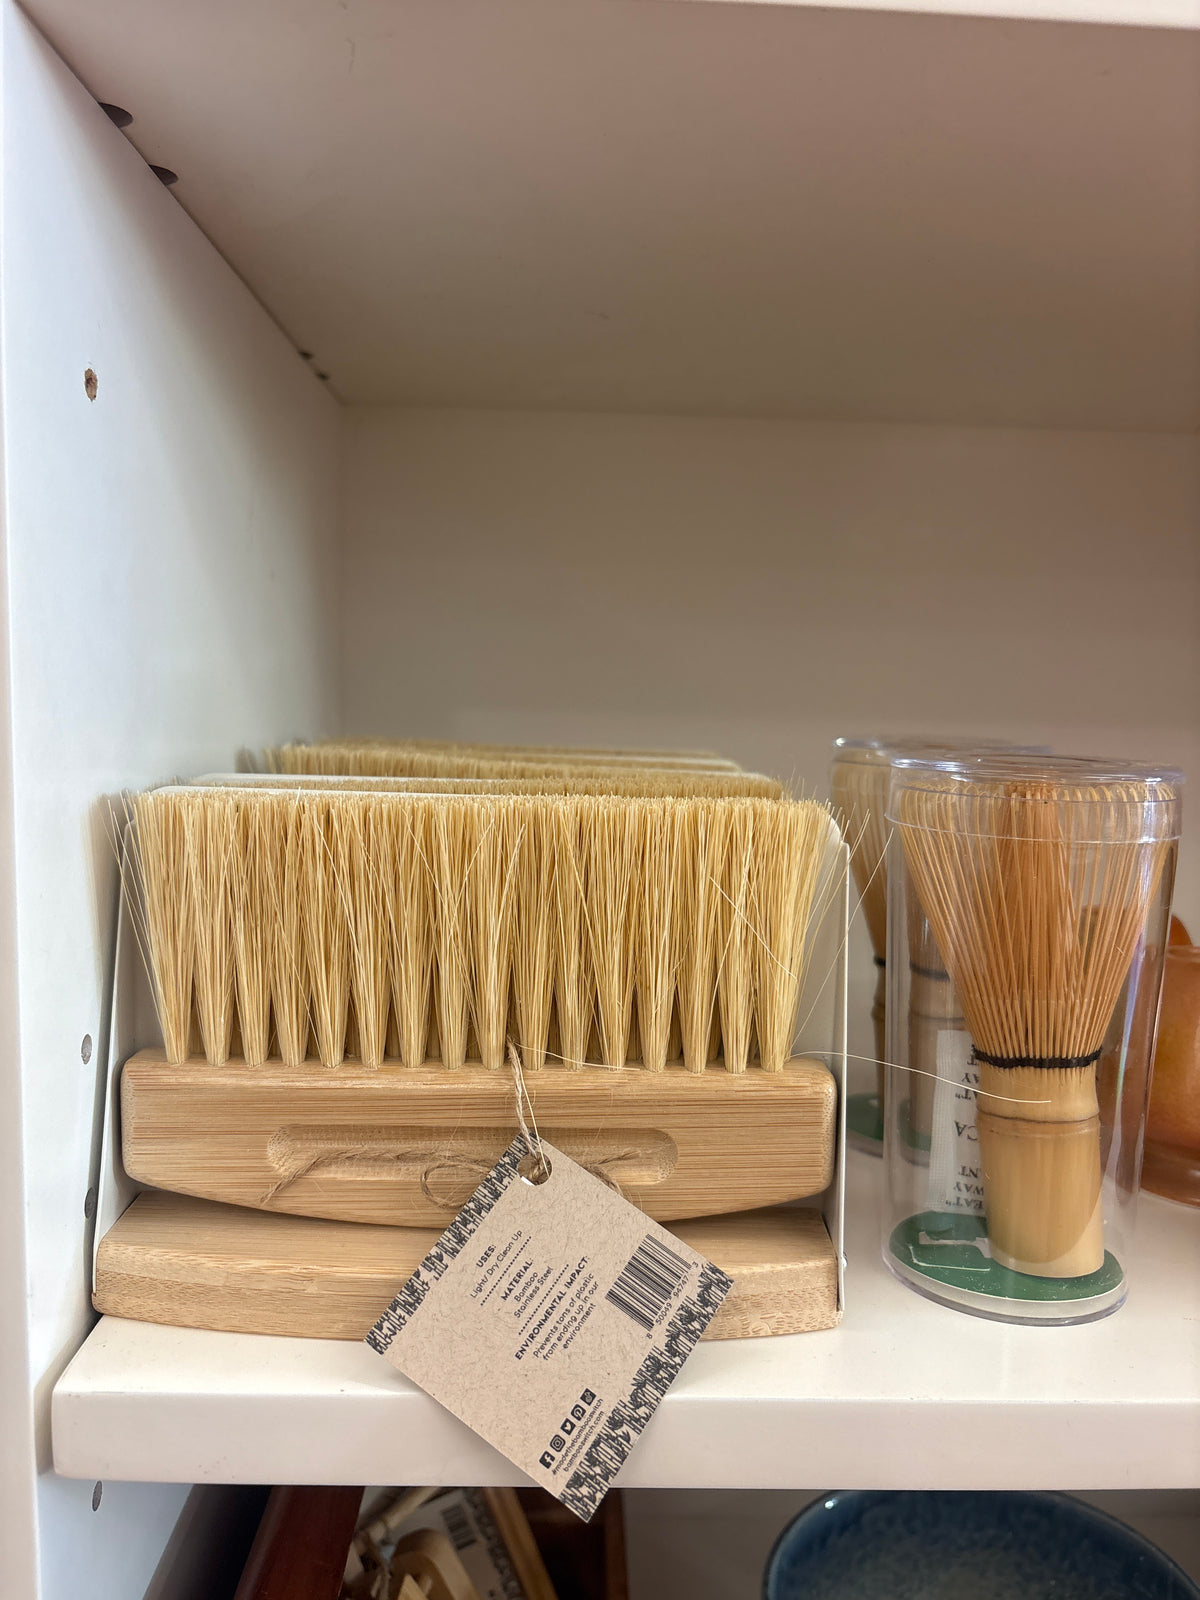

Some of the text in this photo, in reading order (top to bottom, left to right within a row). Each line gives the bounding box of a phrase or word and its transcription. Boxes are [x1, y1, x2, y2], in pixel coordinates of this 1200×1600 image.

[470, 1230, 522, 1298] Light/ Dry Clean Up
[476, 1244, 496, 1267] USES:
[501, 1258, 533, 1300] MATERIAL:
[514, 1272, 538, 1302] Bamboo
[514, 1266, 553, 1318] Stainless Steel
[515, 1256, 589, 1360] ENVIRONMENTAL IMPACT:
[655, 1302, 672, 1325] 50049
[673, 1275, 688, 1298] 94747
[533, 1273, 594, 1358] Prevents tons of plastic
[542, 1281, 598, 1360] from ending up in our
[563, 1303, 596, 1349] environment
[563, 1411, 604, 1472] bambooswitch.com
